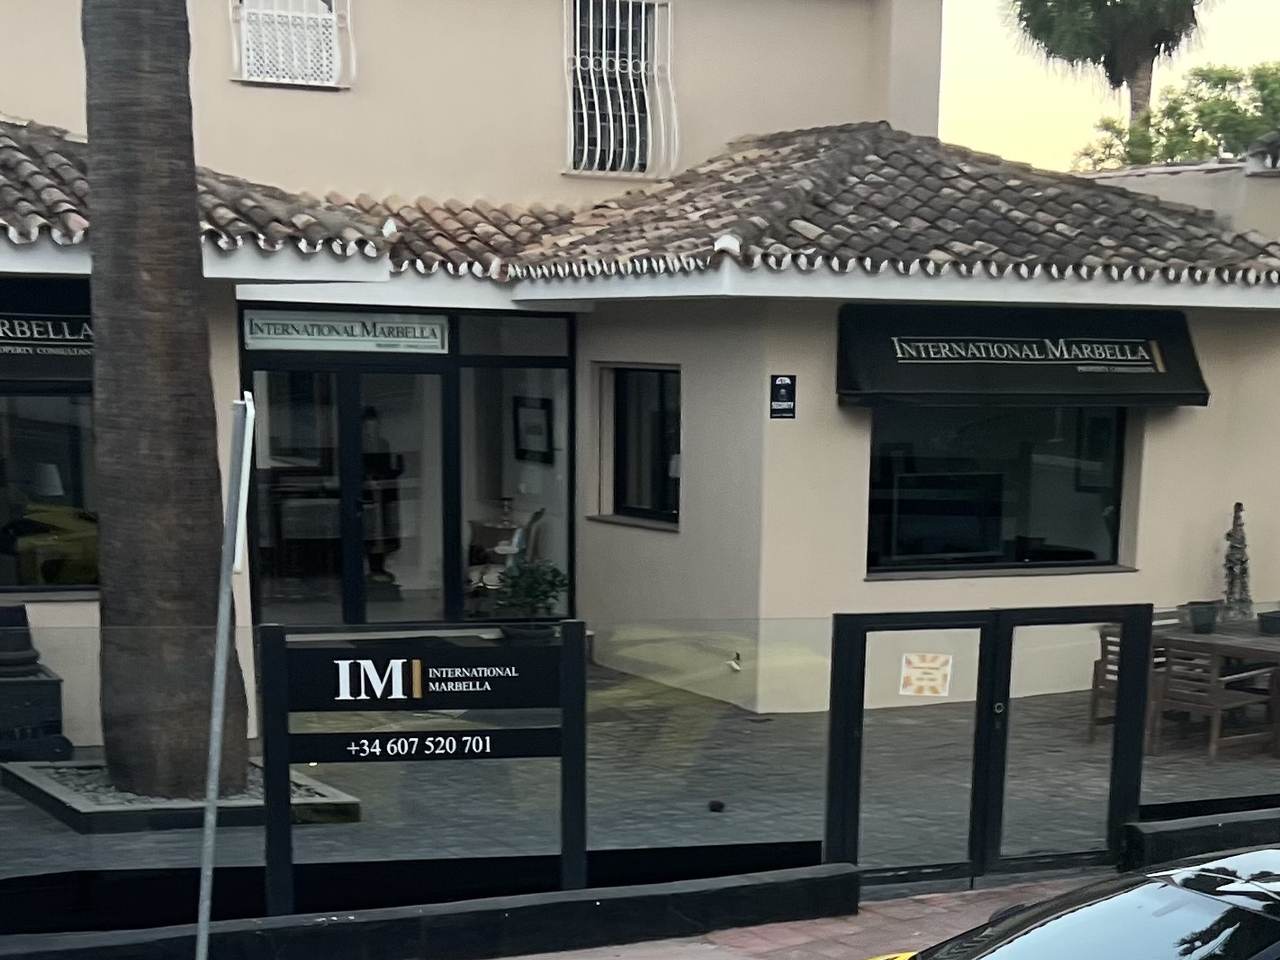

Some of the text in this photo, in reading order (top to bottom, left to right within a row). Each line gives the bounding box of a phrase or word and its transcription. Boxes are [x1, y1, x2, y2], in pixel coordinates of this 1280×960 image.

[250, 318, 438, 340] INTERNATIONAL MARBELLA
[891, 337, 1150, 360] INTERNATIONAL MARBELLA
[333, 659, 408, 700] IM
[428, 667, 519, 678] INTERNATIONAL
[428, 681, 492, 692] MARBELLA
[347, 736, 492, 757] +34 607 520 701
